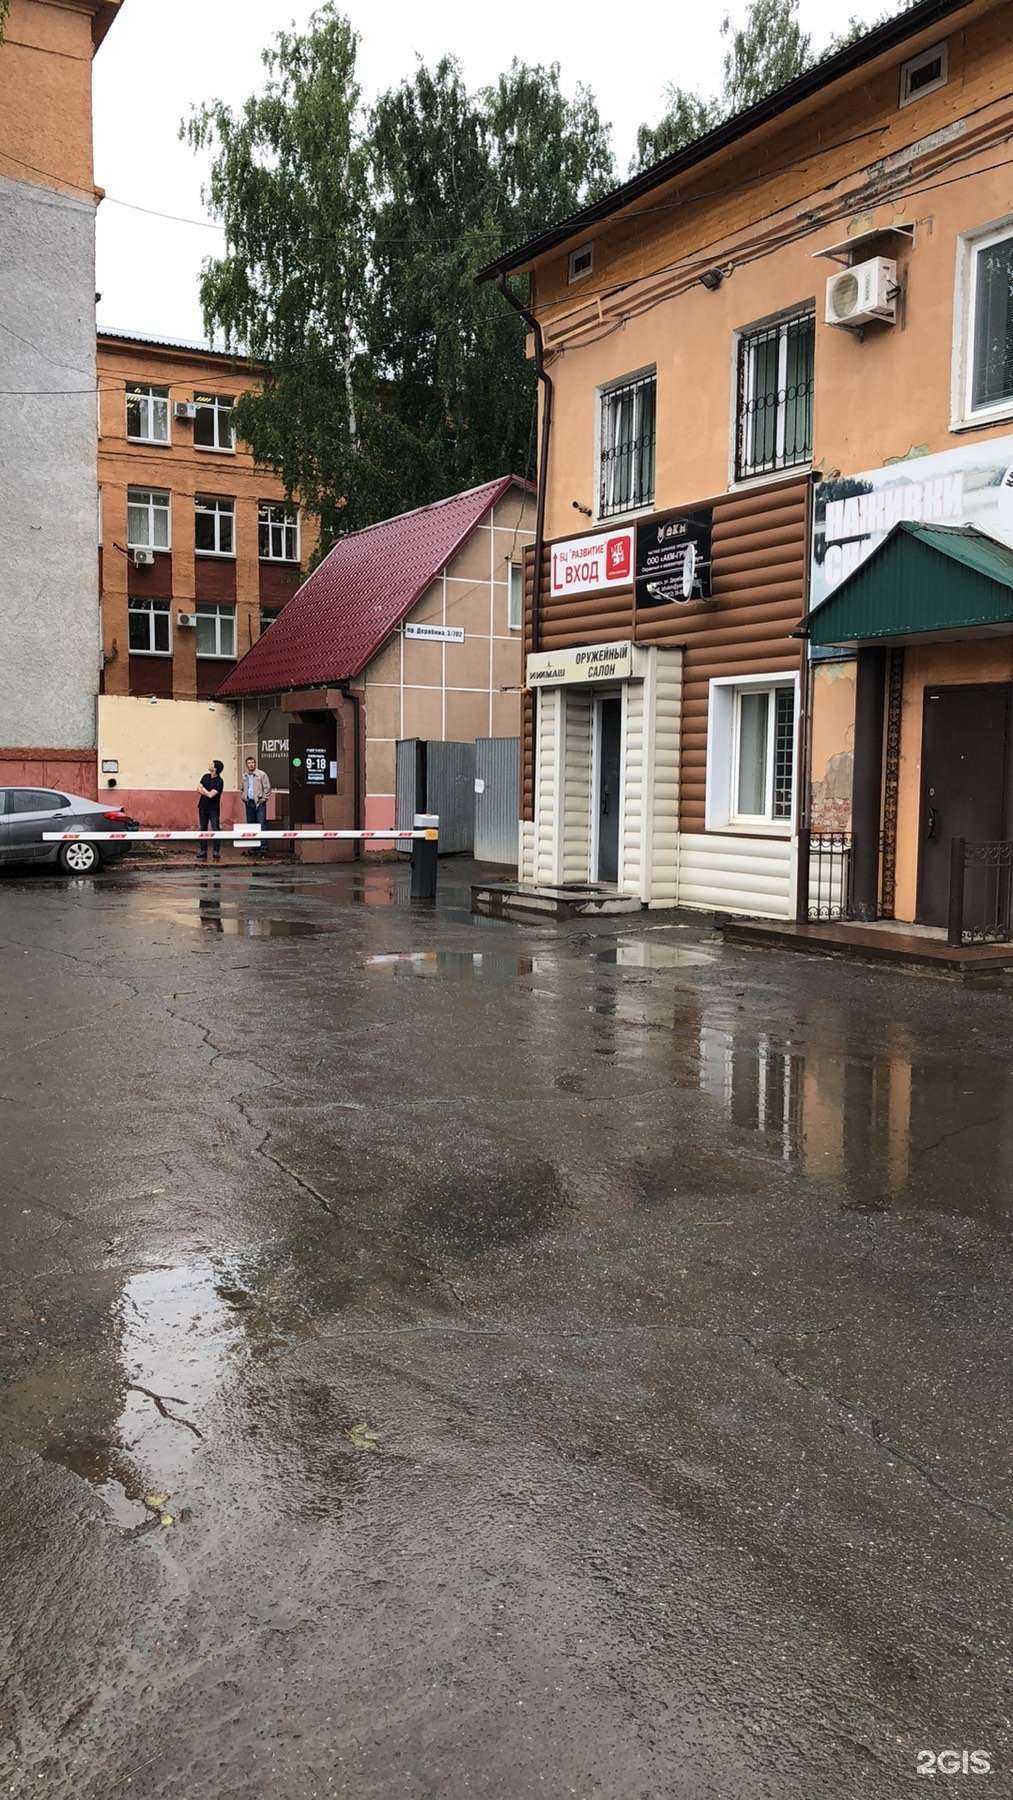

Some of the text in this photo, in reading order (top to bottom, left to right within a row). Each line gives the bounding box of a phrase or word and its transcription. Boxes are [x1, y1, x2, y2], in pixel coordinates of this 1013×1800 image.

[565, 561, 600, 584] ВХОД
[575, 644, 628, 665] ОРУЖЕЙНЫЙ
[587, 663, 615, 678] САЛОН
